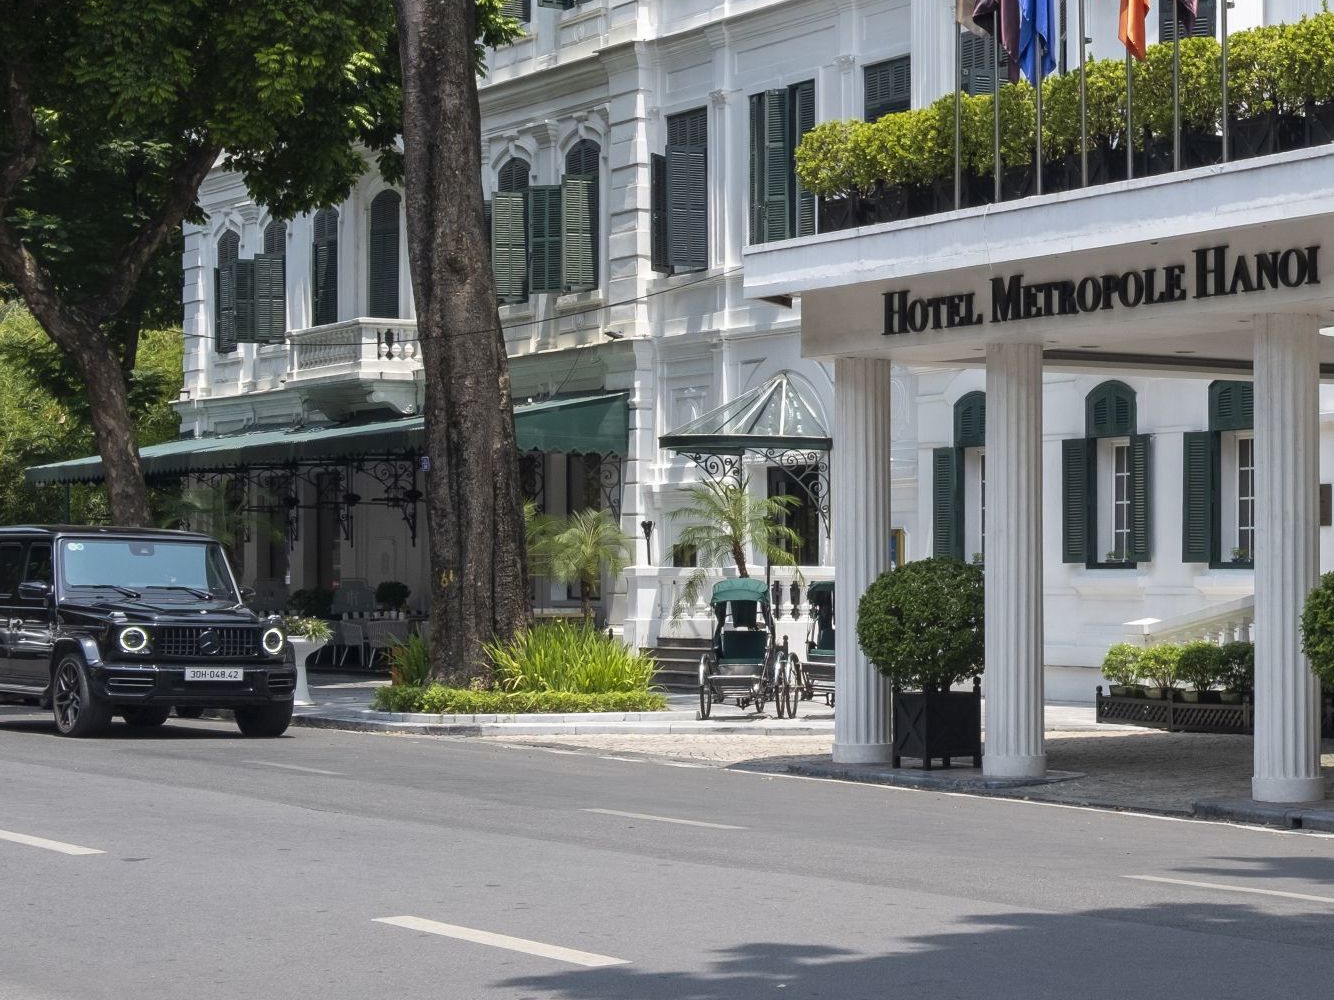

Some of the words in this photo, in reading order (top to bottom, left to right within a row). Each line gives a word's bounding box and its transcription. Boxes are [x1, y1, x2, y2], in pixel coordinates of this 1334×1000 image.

[881, 289, 984, 336] HOTEL
[990, 264, 1187, 323] METROPOLE
[1192, 245, 1321, 299] HANOI
[190, 670, 239, 679] 30H-048.42
